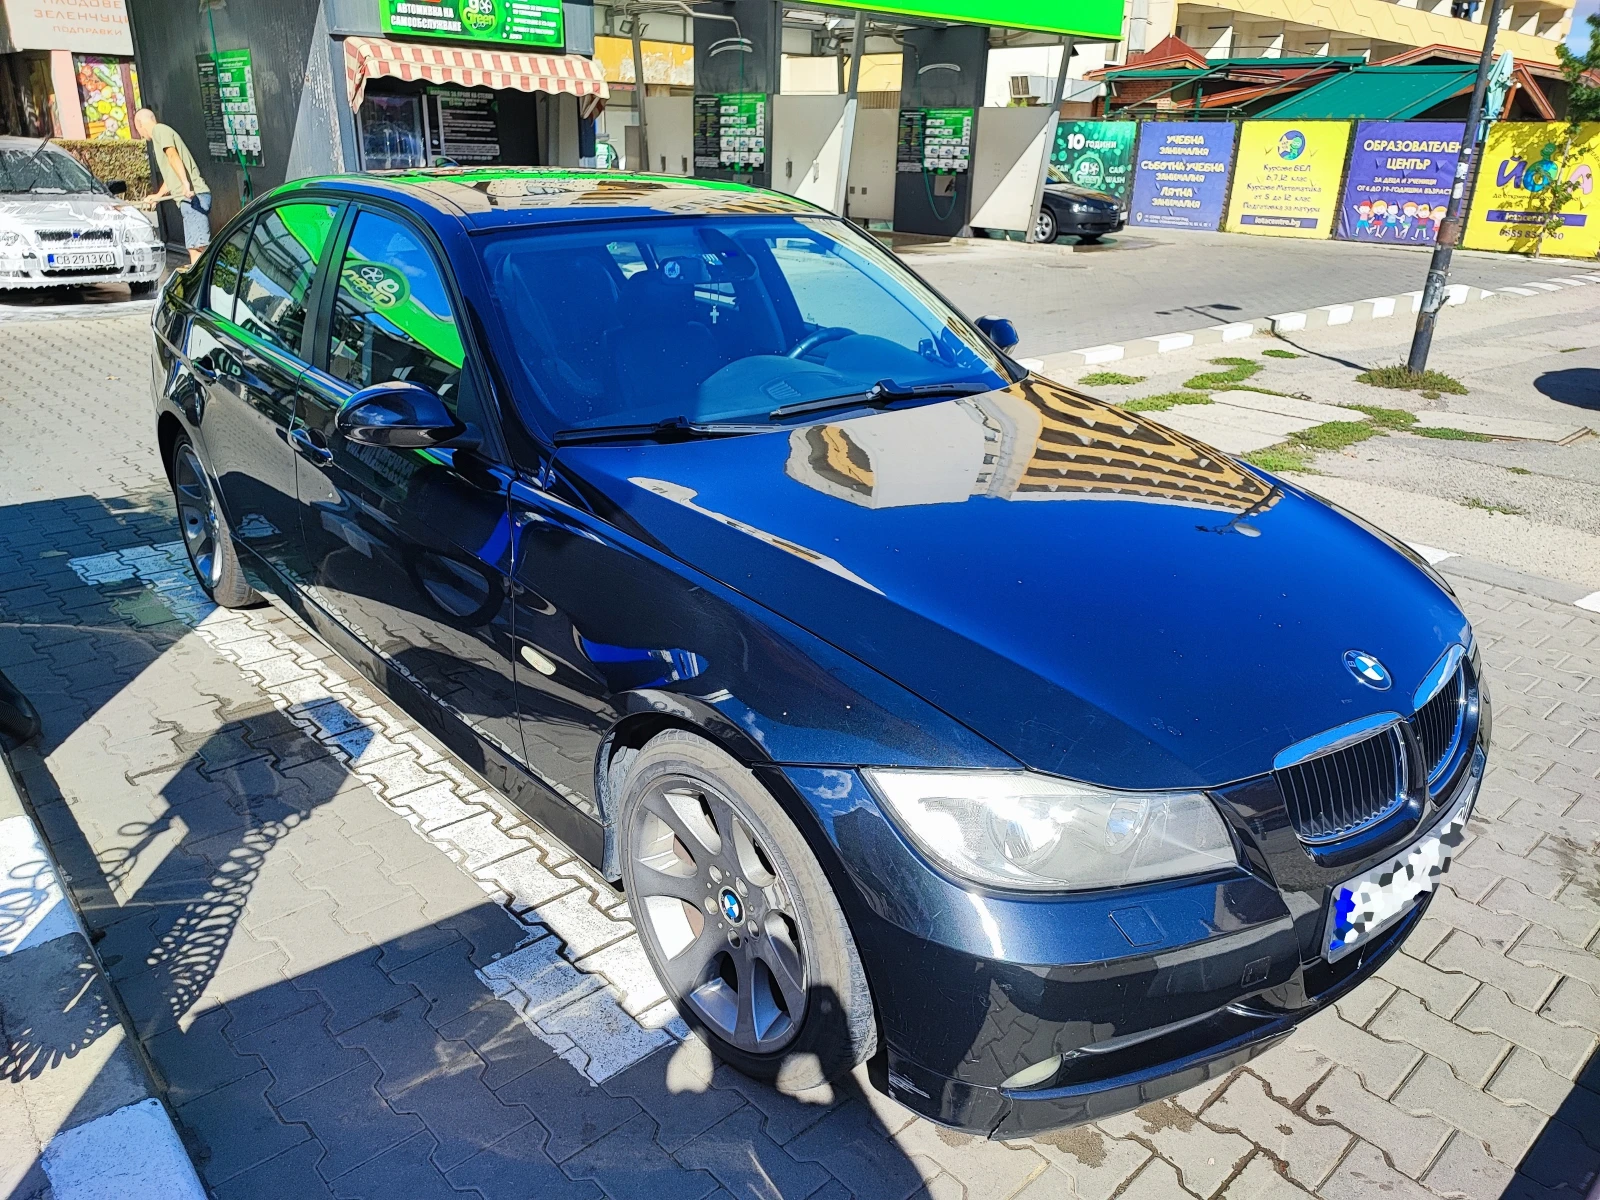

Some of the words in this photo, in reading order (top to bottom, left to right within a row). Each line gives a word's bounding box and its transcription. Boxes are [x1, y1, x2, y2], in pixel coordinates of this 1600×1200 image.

[443, 7, 455, 18] НА
[52, 26, 123, 36] ПОДПРАВКИ
[1067, 133, 1085, 150] 10
[1166, 135, 1205, 145] УЧЕБНА
[1159, 146, 1209, 156] ЗАНИМАЛНЯ
[1141, 160, 1185, 171] СЪБОТНА
[1185, 162, 1225, 172] УЧЕБНА
[1263, 164, 1292, 172] Курсове
[1294, 164, 1311, 172] БЕЛ
[1386, 157, 1431, 170] ЦЕНТЪР
[1109, 166, 1124, 174] CAR
[1155, 172, 1205, 182] ЗАНИМАЛНЯ
[1160, 186, 1193, 197] ЛЯТНА
[1246, 183, 1275, 191] Курсове
[1276, 184, 1321, 193] Математика
[1151, 197, 1201, 208] ЗАНИМАЛНЯ
[1242, 202, 1283, 211] Подготовка
[72, 254, 97, 265] 2913
